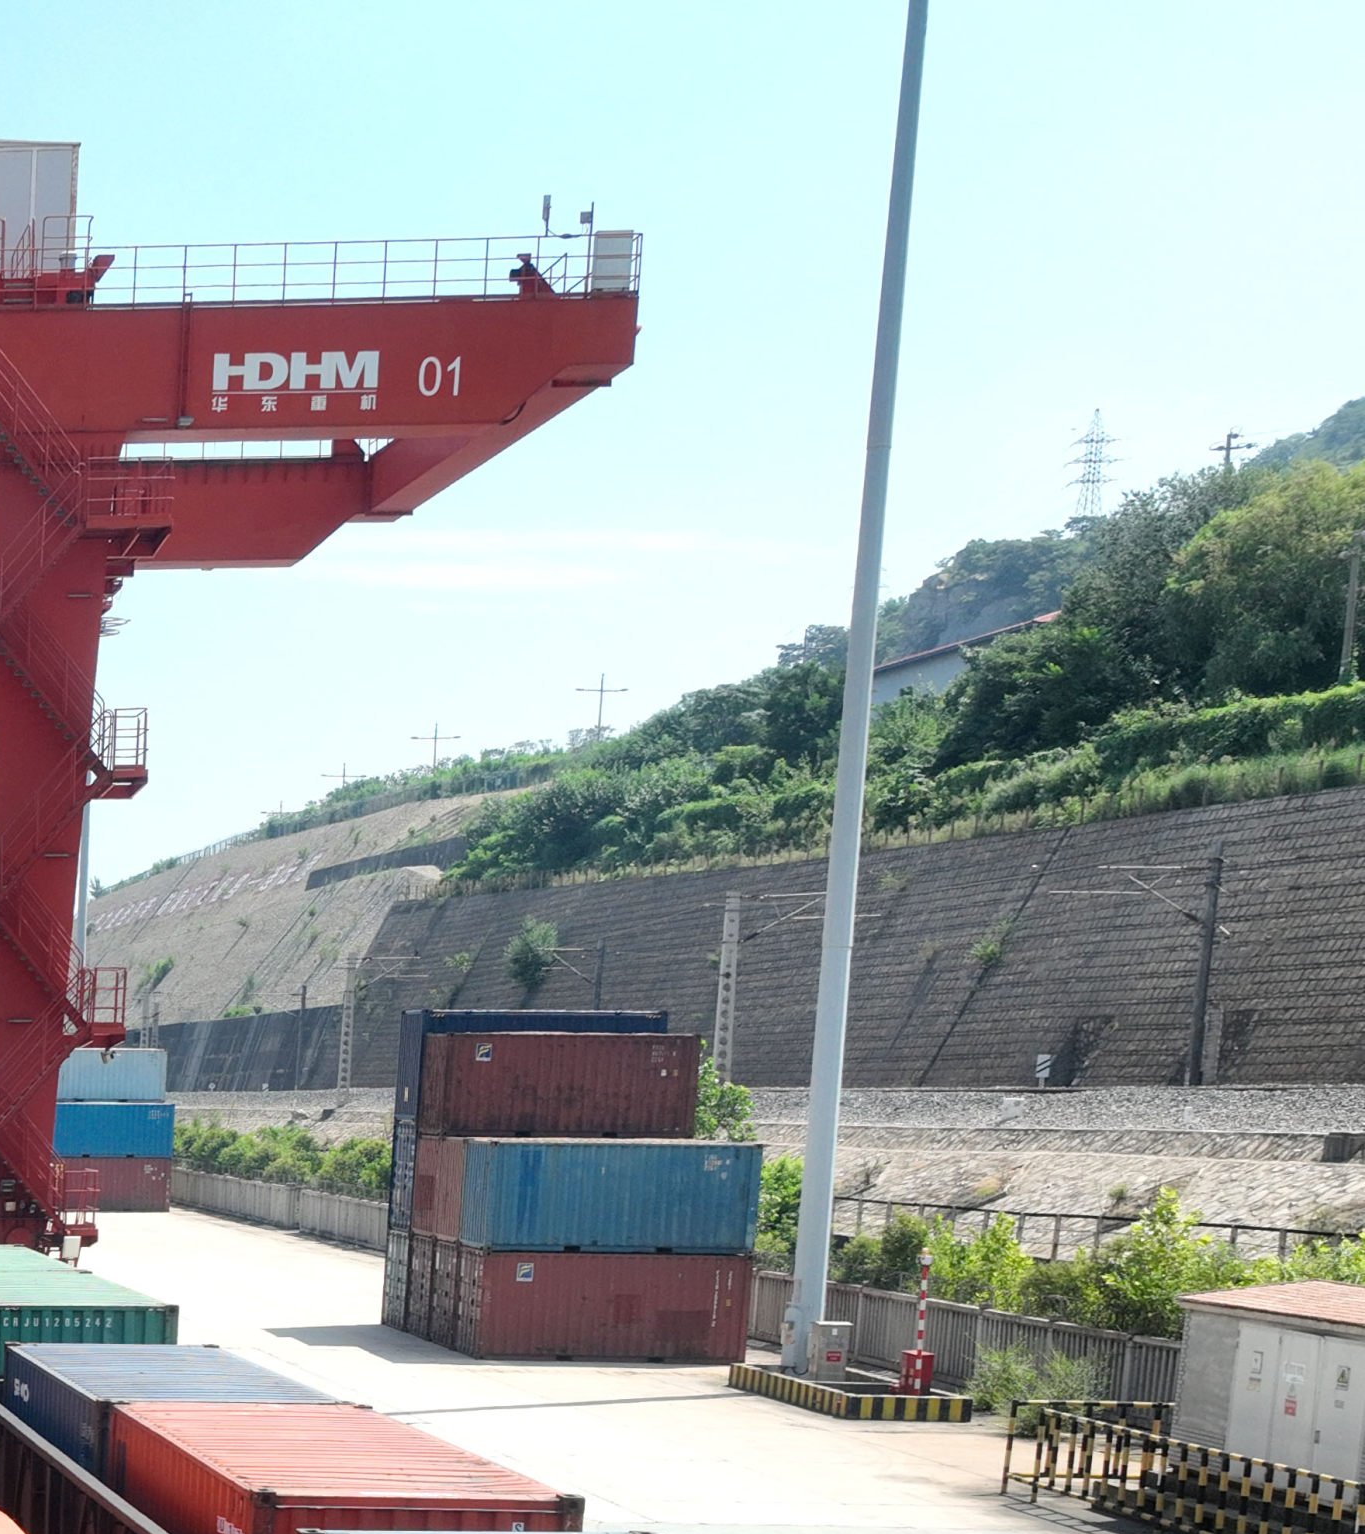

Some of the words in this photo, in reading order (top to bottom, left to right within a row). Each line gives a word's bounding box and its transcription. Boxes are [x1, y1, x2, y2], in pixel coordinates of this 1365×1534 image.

[212, 351, 379, 390] HDHM
[418, 356, 461, 397] 01
[211, 395, 377, 413] 华东重机
